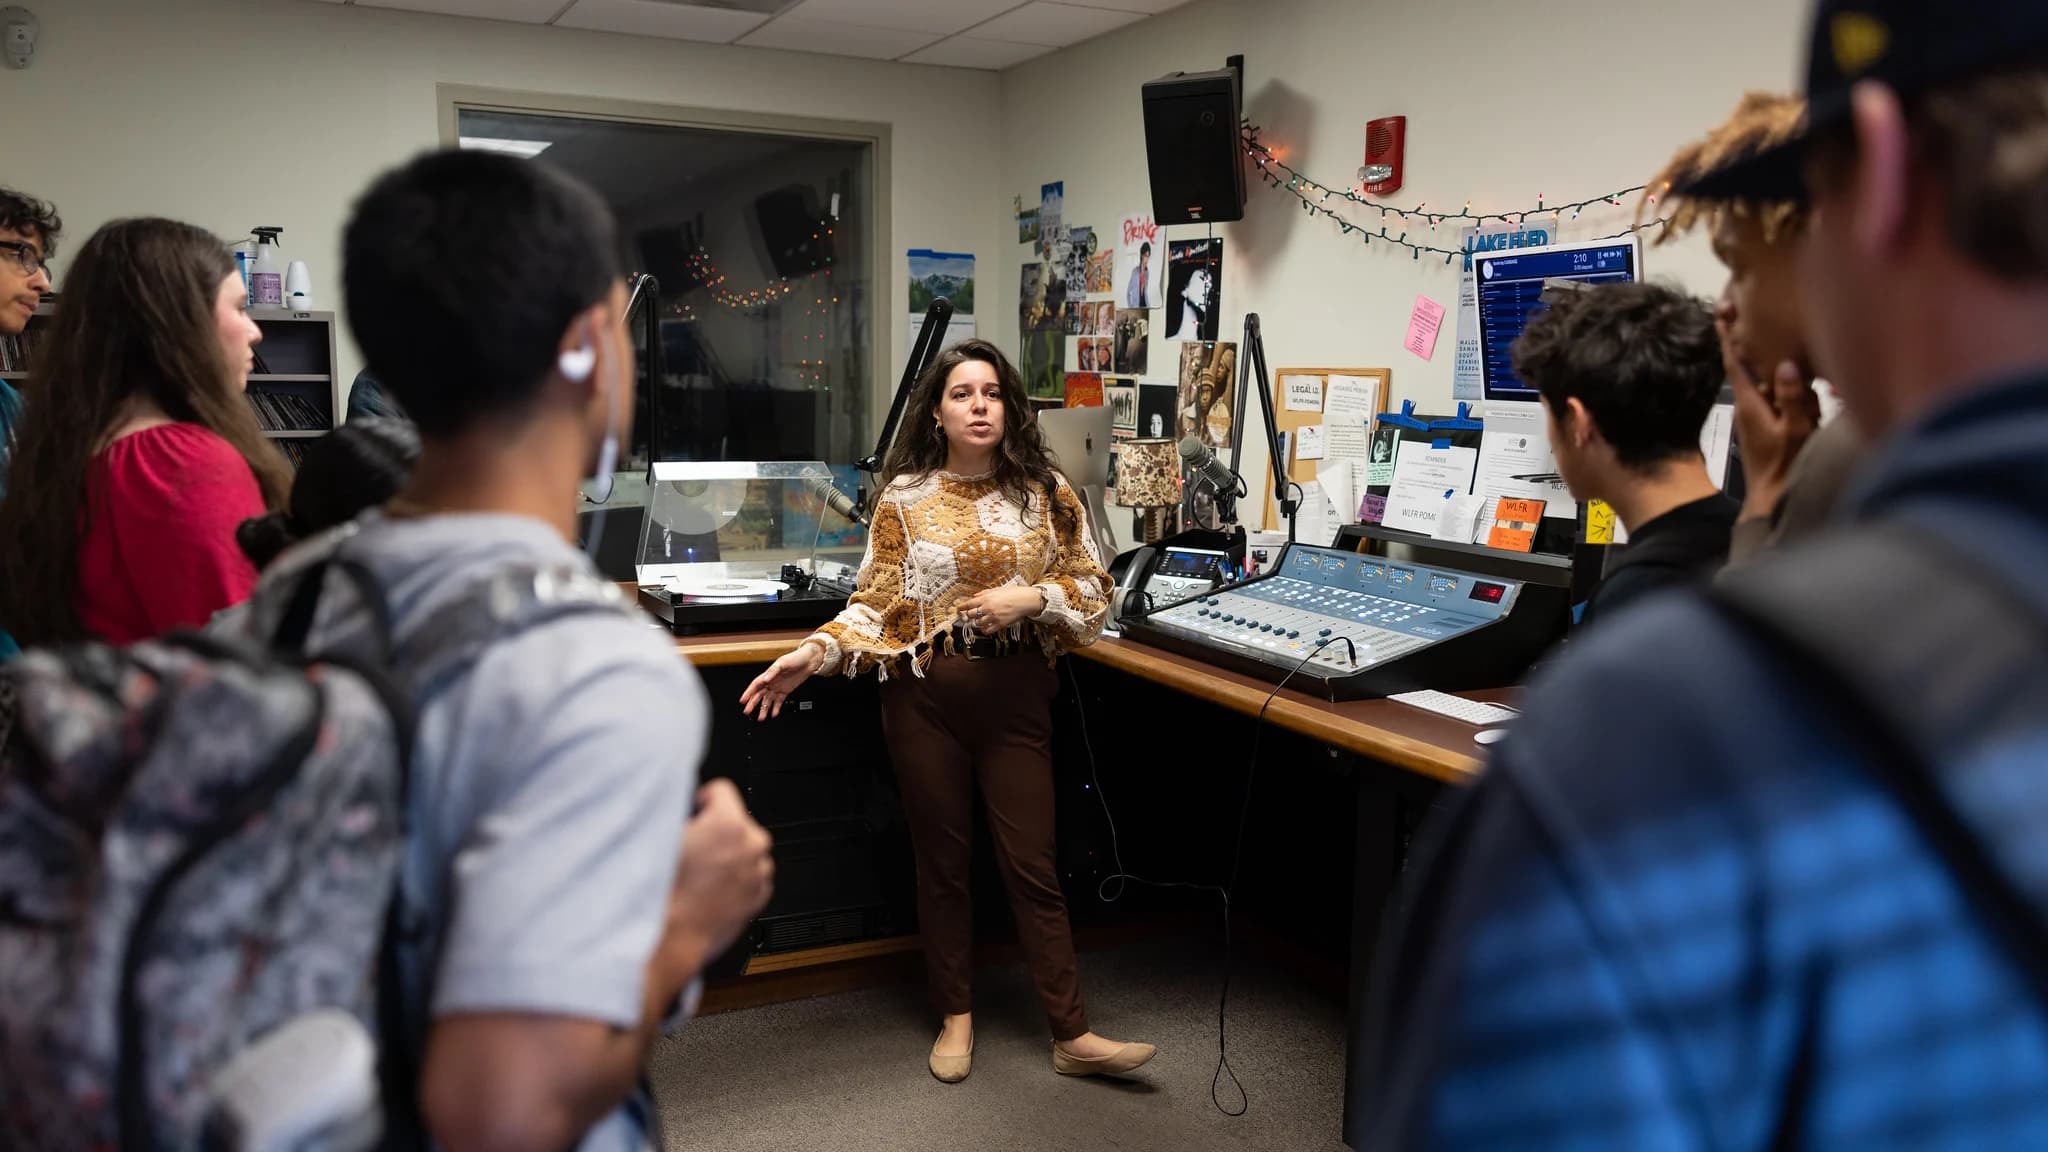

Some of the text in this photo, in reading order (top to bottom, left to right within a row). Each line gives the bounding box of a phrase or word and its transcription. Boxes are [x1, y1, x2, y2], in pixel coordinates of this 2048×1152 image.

[1367, 183, 1383, 192] FIRE
[1467, 232, 1507, 253] LAKE
[1573, 253, 1587, 263] 2:10
[1291, 385, 1311, 393] LEGAL
[1506, 501, 1528, 513] WLFR
[1402, 507, 1418, 519] WLFR
